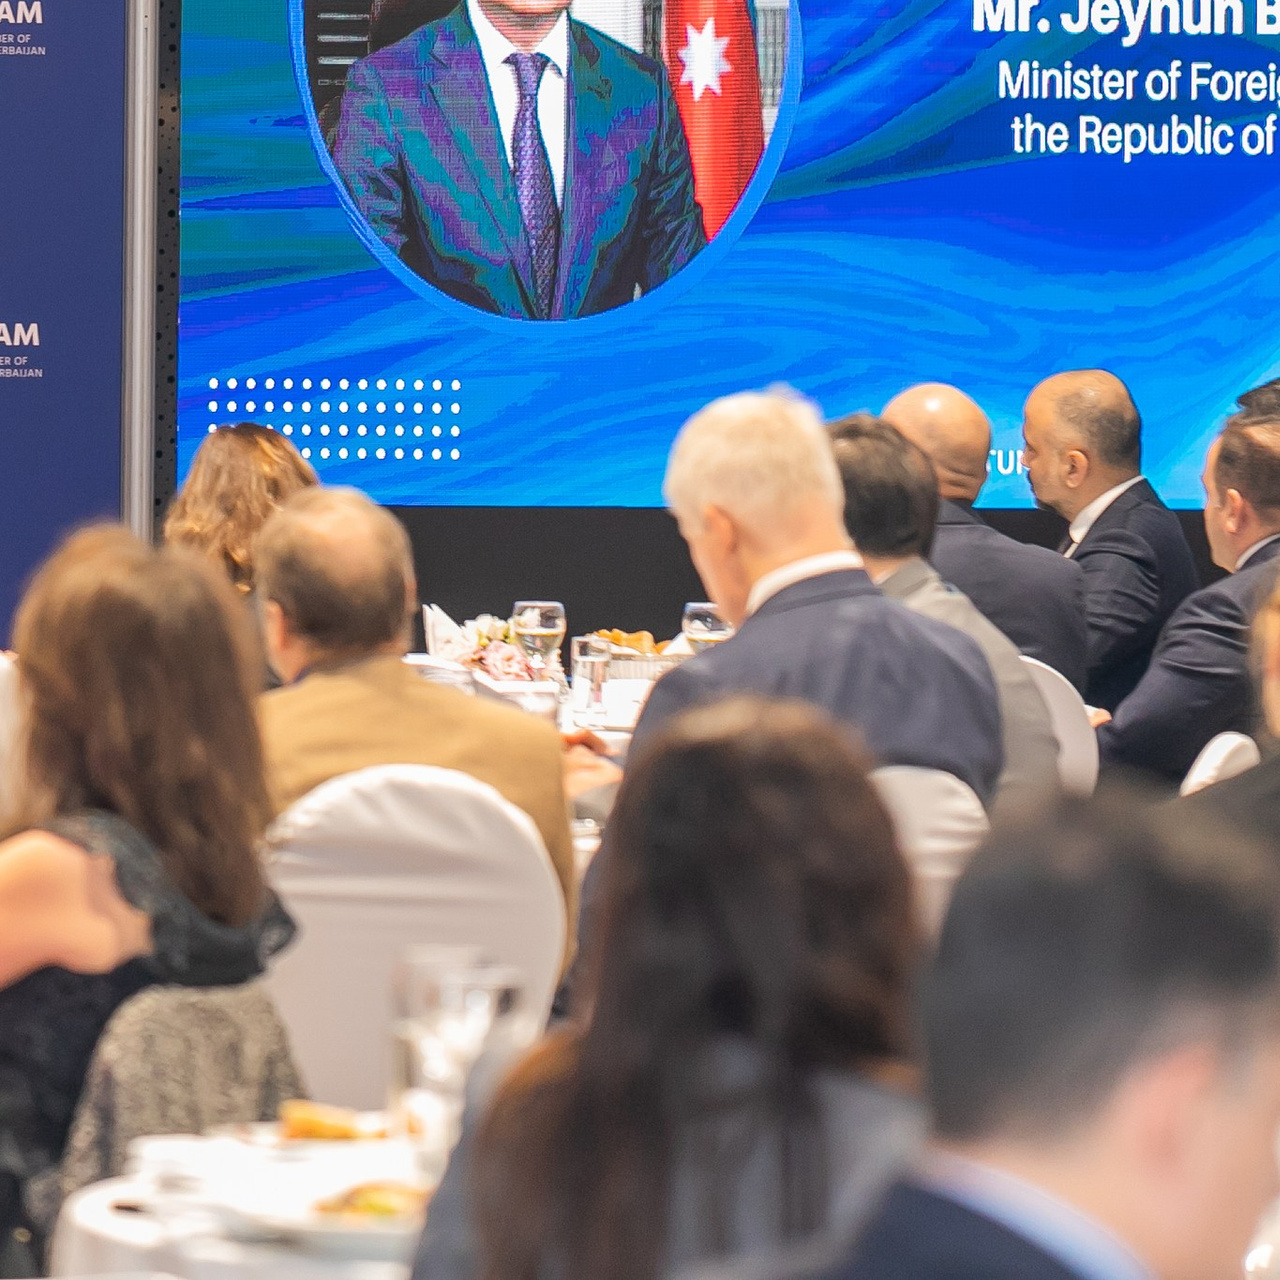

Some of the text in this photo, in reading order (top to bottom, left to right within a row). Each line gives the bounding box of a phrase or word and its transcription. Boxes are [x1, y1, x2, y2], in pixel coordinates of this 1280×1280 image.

[16, 33, 32, 44] OF
[998, 59, 1280, 108] Minister of Forei
[1011, 113, 1278, 164] the Republic of
[13, 356, 28, 366] OF
